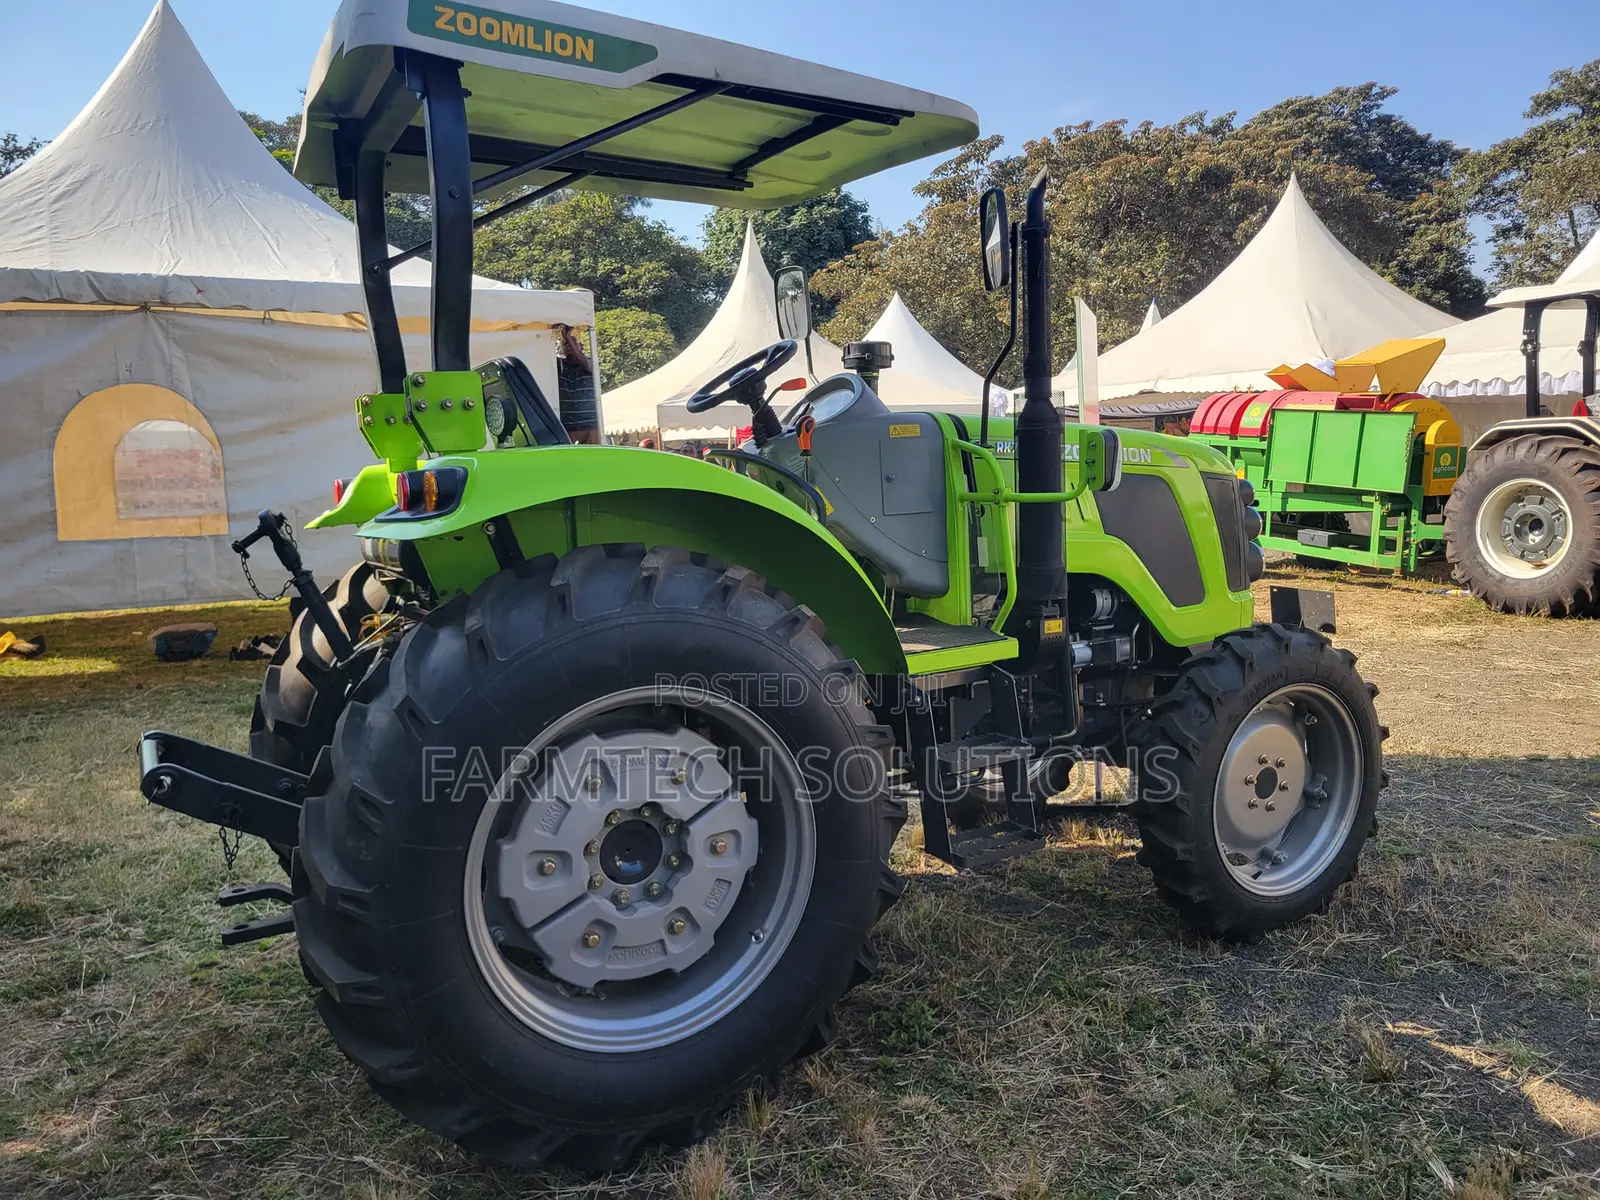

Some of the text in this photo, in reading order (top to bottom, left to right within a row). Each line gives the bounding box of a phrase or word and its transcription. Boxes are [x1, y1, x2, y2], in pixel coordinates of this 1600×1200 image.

[433, 5, 595, 63] ZOOMLION
[1061, 443, 1152, 463] ZOION
[611, 755, 669, 767] ZOOMLON
